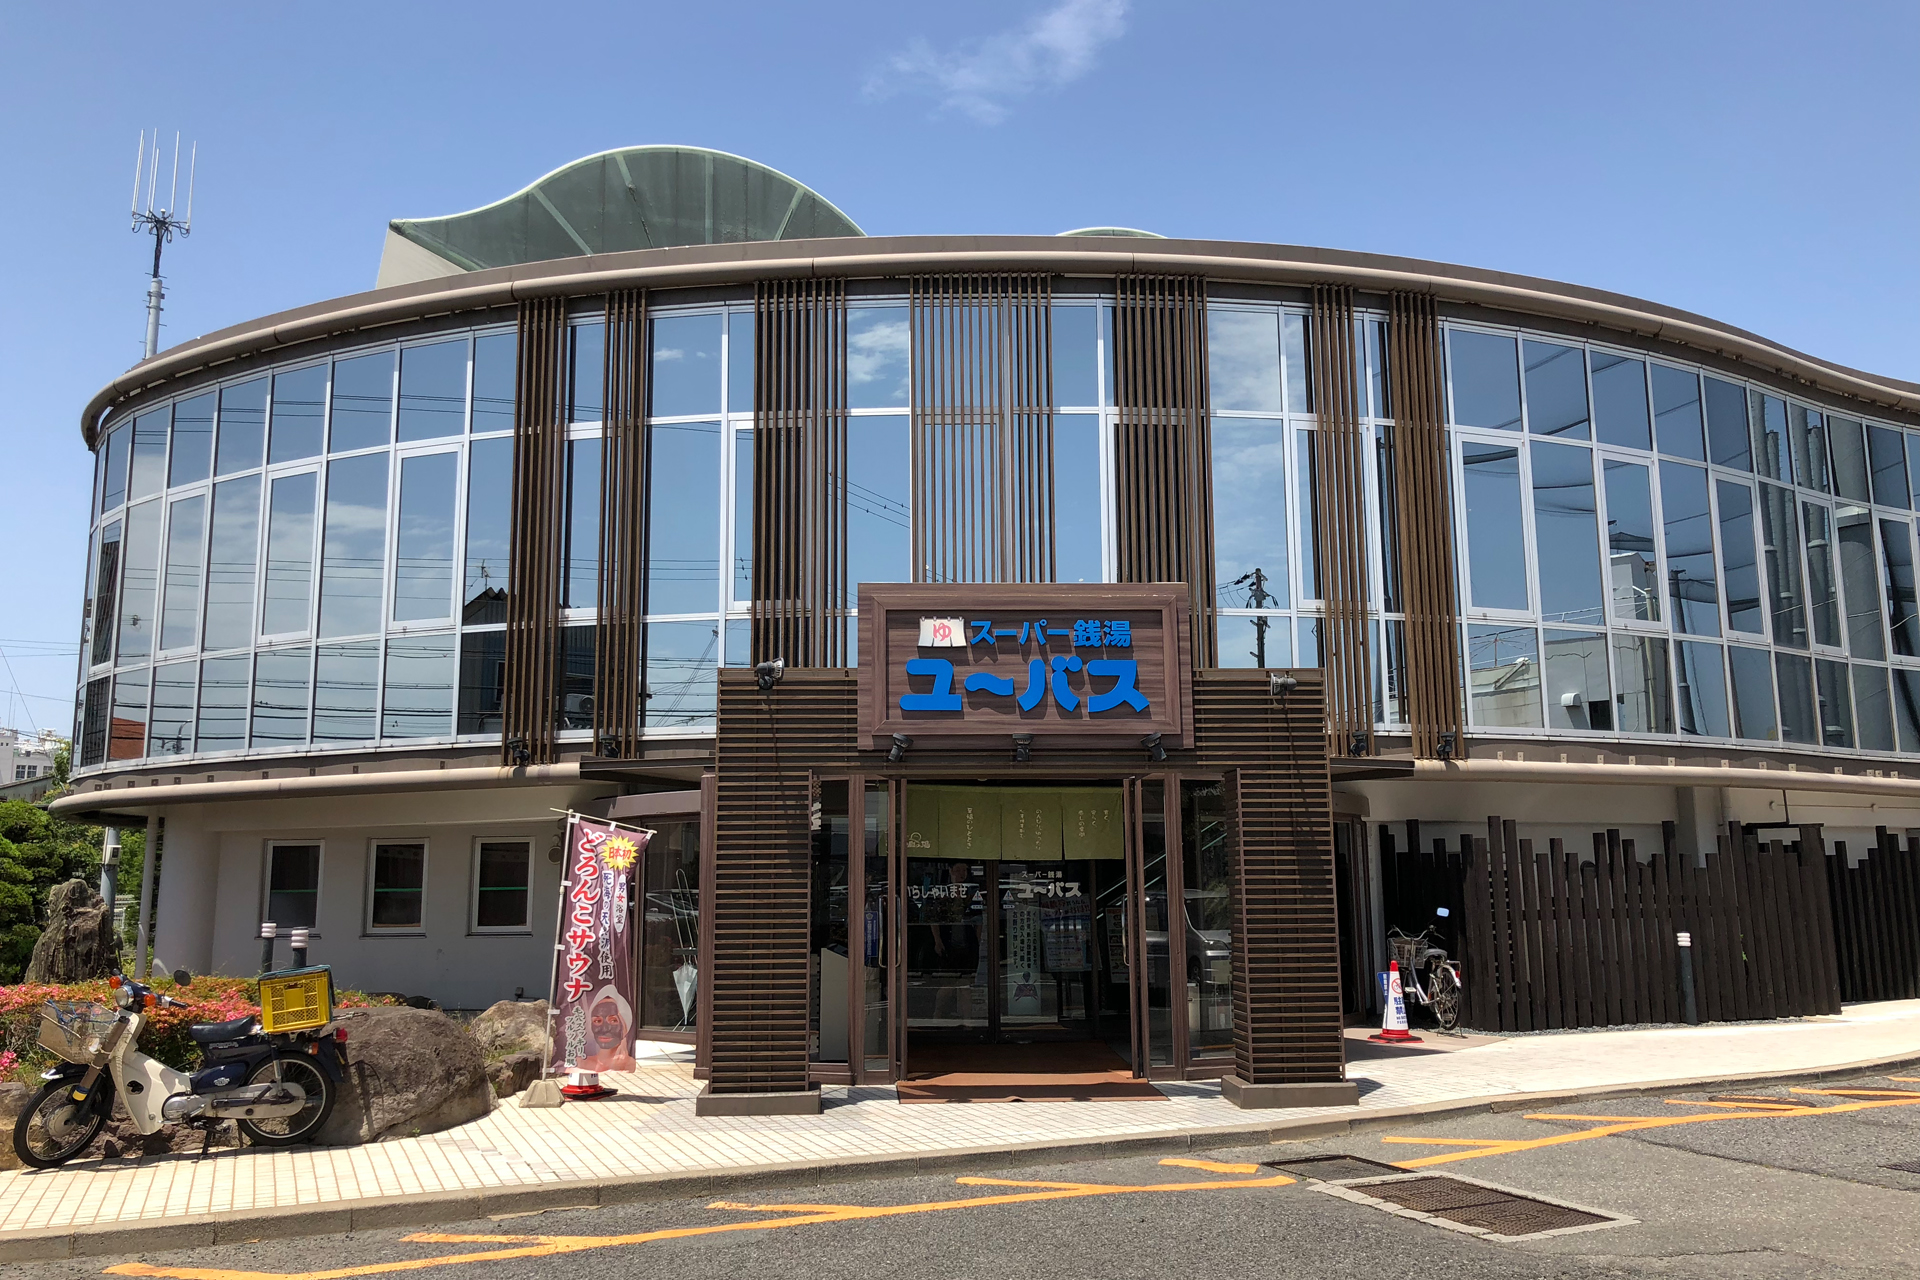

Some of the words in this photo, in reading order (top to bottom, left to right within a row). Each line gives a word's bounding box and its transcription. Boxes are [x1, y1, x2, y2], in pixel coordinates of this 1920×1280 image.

[932, 622, 952, 642] ゆ
[969, 618, 1132, 648] スーパー銭湯
[608, 844, 632, 861] 日本初
[1021, 870, 1063, 879] スーパー銭湯
[564, 828, 605, 1001] どろんこサウナ
[615, 881, 627, 925] 男女浴室
[565, 1017, 576, 1067] ツルツルお肌
